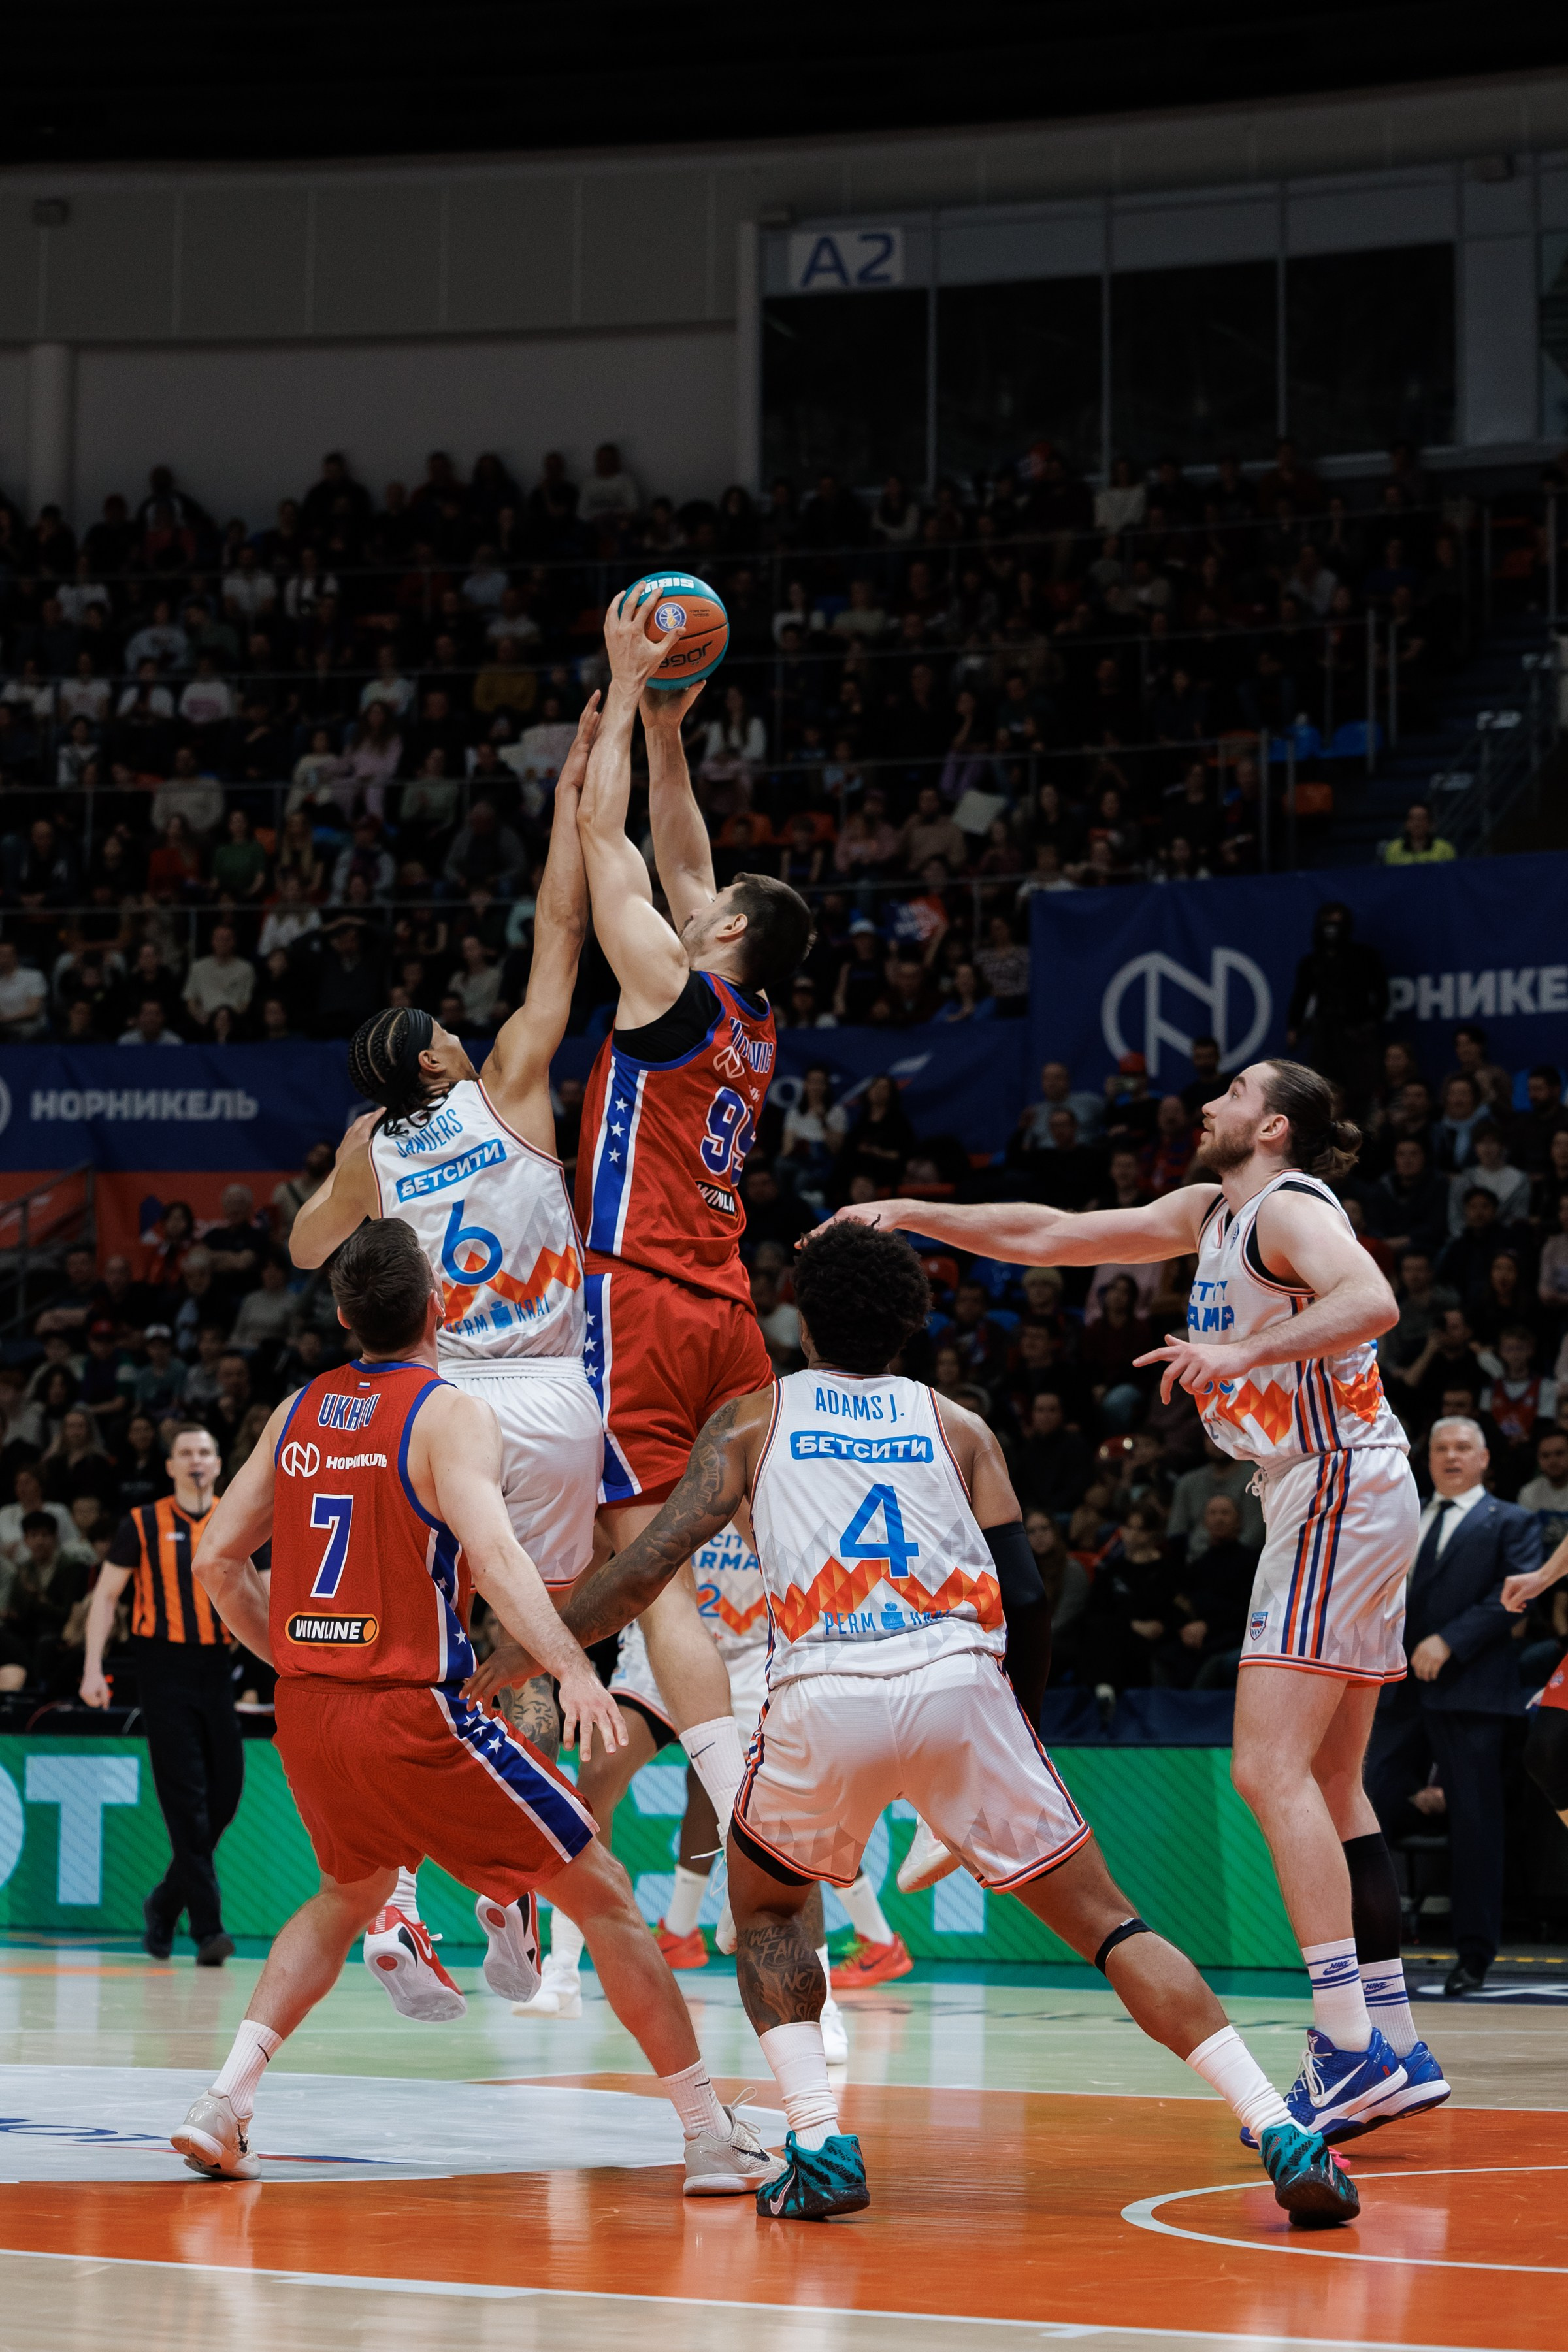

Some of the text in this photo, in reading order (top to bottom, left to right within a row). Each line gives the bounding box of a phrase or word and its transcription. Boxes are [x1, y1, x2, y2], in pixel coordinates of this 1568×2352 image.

[800, 233, 896, 287] A2
[31, 1087, 259, 1121] НОРНИКЕЛЬ
[401, 1142, 500, 1198] БЕТСИТИ
[442, 1199, 503, 1286] 6
[815, 1387, 905, 1424] ADAMS J.
[796, 1435, 928, 1459] БЕТСИТИ
[310, 1493, 354, 1599] 7
[839, 1483, 920, 1579] 4
[295, 1619, 362, 1640] WINLINE
[824, 1612, 877, 1635] PERM
[1330, 1960, 1350, 1969] NIKE
[1365, 1982, 1387, 1990] NIKE
